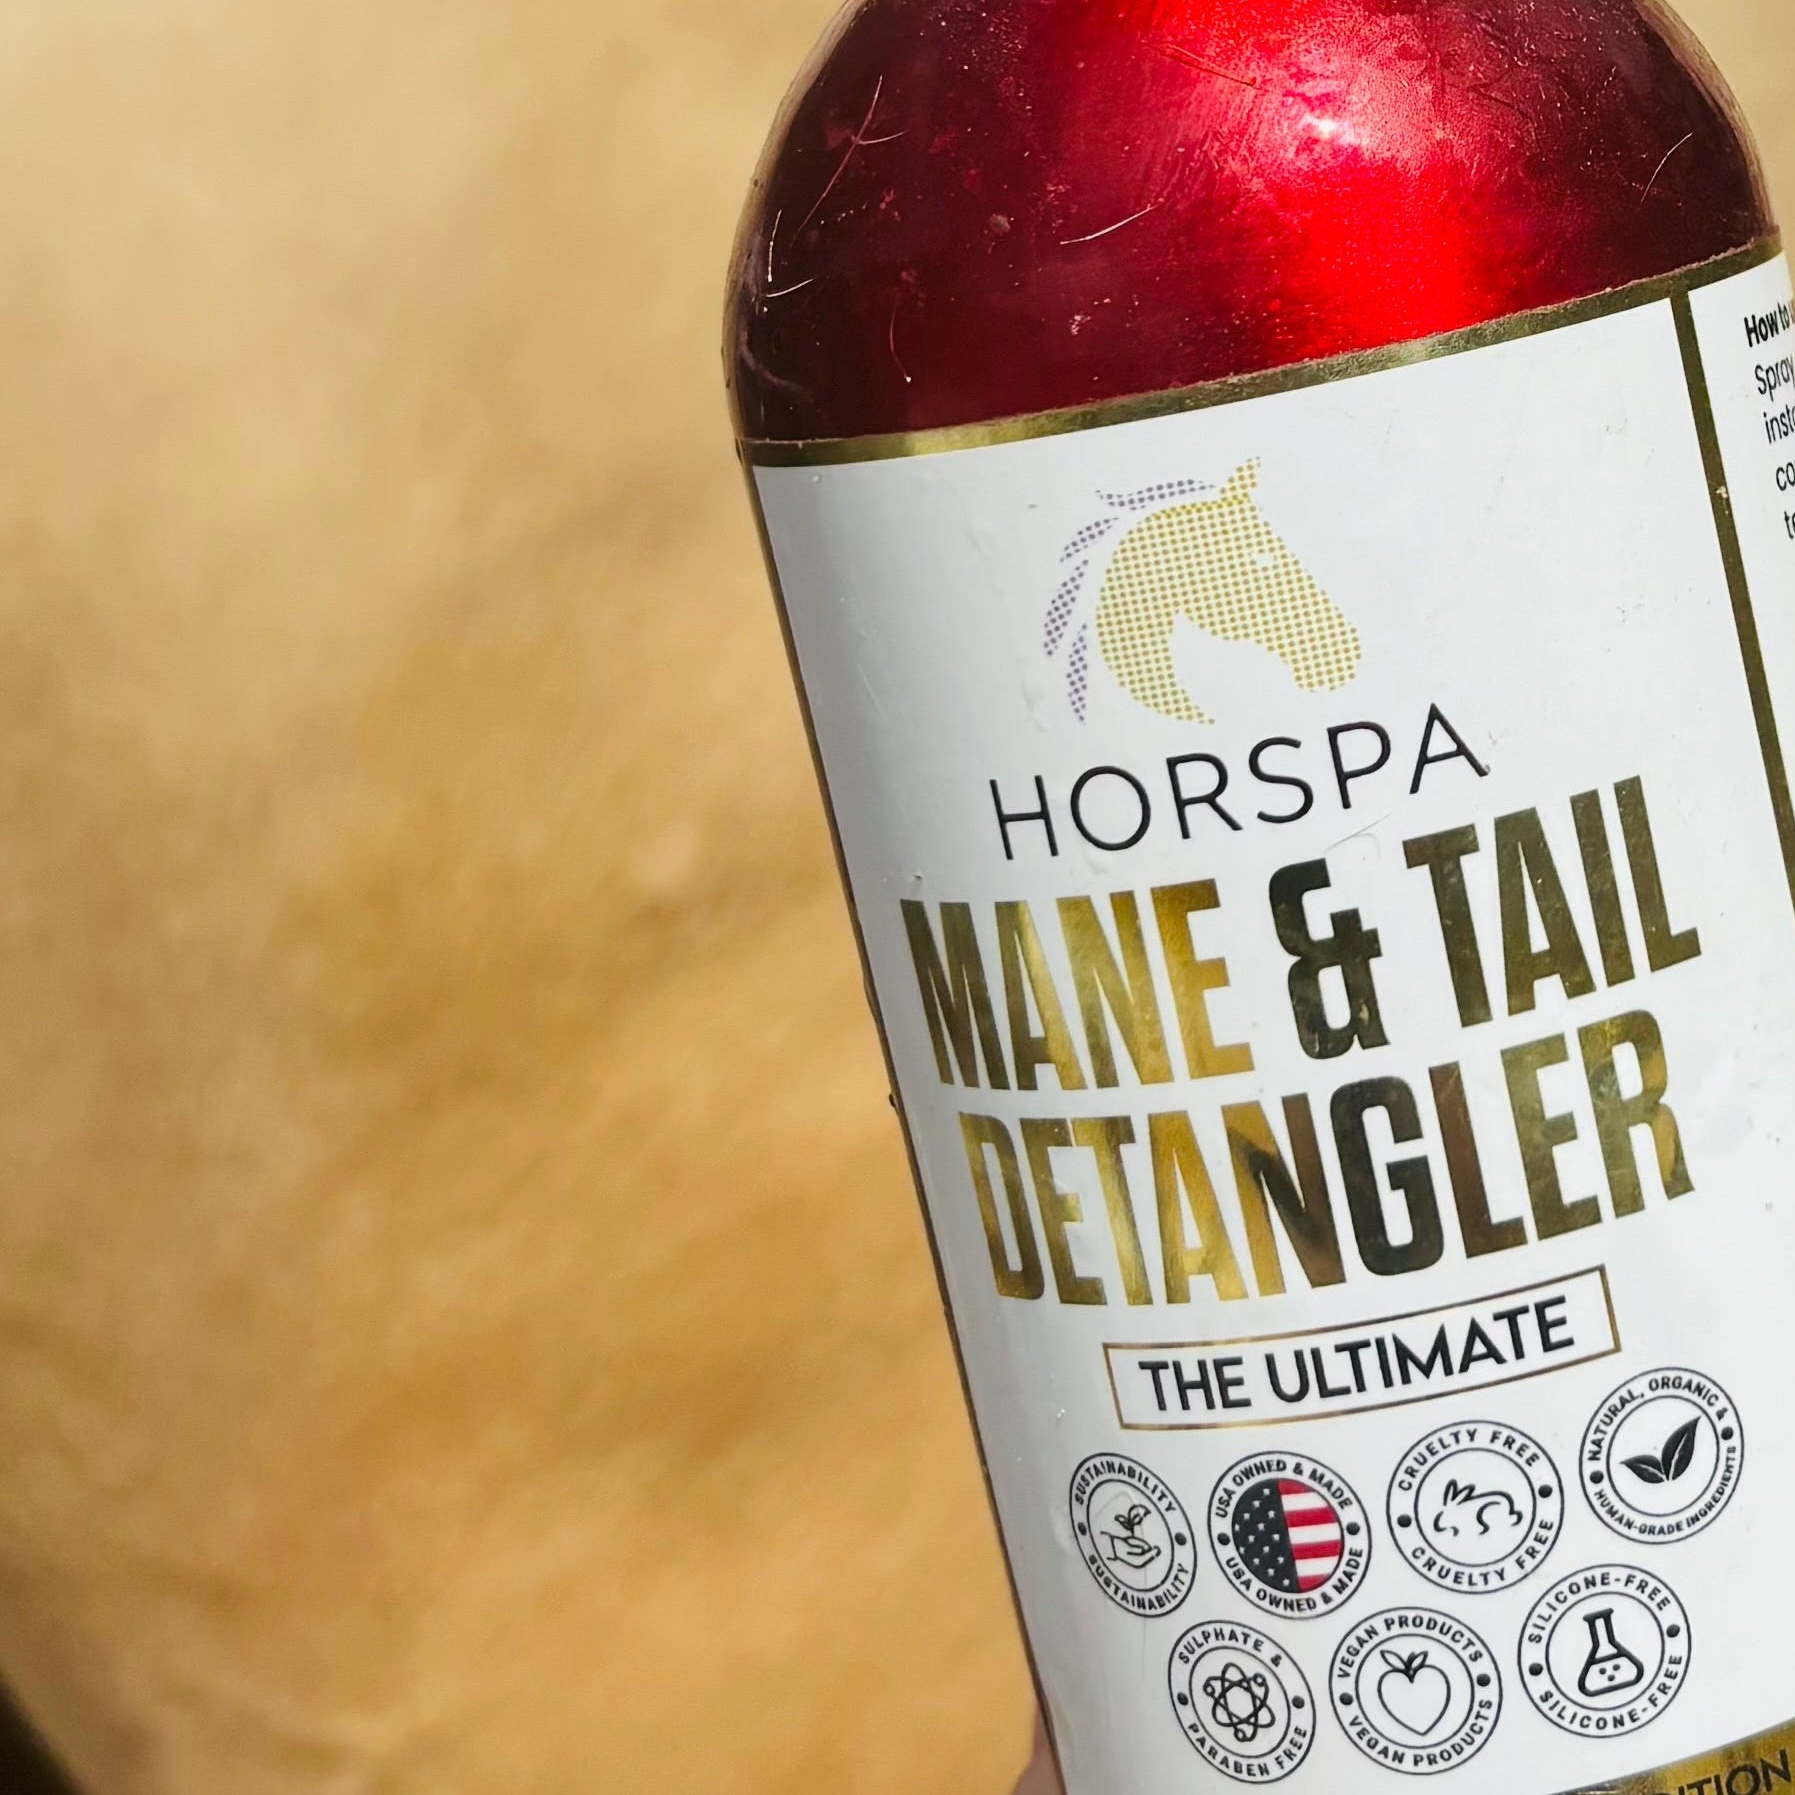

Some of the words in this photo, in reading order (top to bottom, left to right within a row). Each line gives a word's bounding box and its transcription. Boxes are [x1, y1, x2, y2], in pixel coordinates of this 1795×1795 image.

[1743, 309, 1779, 348] How
[1777, 302, 1790, 331] to
[1754, 353, 1795, 402] Spray
[989, 702, 1489, 861] HORSPA
[901, 877, 1254, 1092] MANE
[1268, 857, 1391, 1061] &
[1401, 774, 1702, 1028] TAIL
[957, 1008, 1695, 1306] DETANGLER
[1138, 1356, 1253, 1412] THE
[1262, 1294, 1576, 1398] ULTIMATE
[1648, 1375, 1719, 1408] ORGANIC
[1715, 1406, 1729, 1422] &
[1073, 1456, 1177, 1515] SUSTAINABILITY
[1215, 1487, 1234, 1519] USA
[1232, 1459, 1287, 1487] OWNED
[1291, 1461, 1305, 1476] &
[1307, 1469, 1354, 1510] MADE
[1397, 1427, 1479, 1493] CRUELTY
[1488, 1430, 1541, 1468] FREE
[1593, 1488, 1685, 1536] HUMAN-GRADE
[1685, 1445, 1737, 1529] INGREDIENTS
[1087, 1553, 1190, 1611] SUSTAINABILITY
[1225, 1556, 1252, 1592] USA
[1255, 1588, 1318, 1613] OWNED
[1321, 1591, 1334, 1606] &
[1330, 1546, 1364, 1597] MADE
[1411, 1546, 1507, 1587] CRUELTY
[1515, 1517, 1555, 1570] FREE
[1527, 1571, 1671, 1646] SILICONE-FREE
[1177, 1626, 1265, 1665] SULPHATE
[1270, 1653, 1283, 1668] &
[1337, 1624, 1380, 1680] VEGAN
[1383, 1614, 1484, 1663] PRODUCTS
[1538, 1653, 1683, 1731] SILICONE-FREE
[1187, 1722, 1271, 1778] PARABEN
[1275, 1725, 1308, 1770] FREE
[1349, 1714, 1406, 1765] VEGAN
[1412, 1699, 1493, 1767] PRODUCTS
